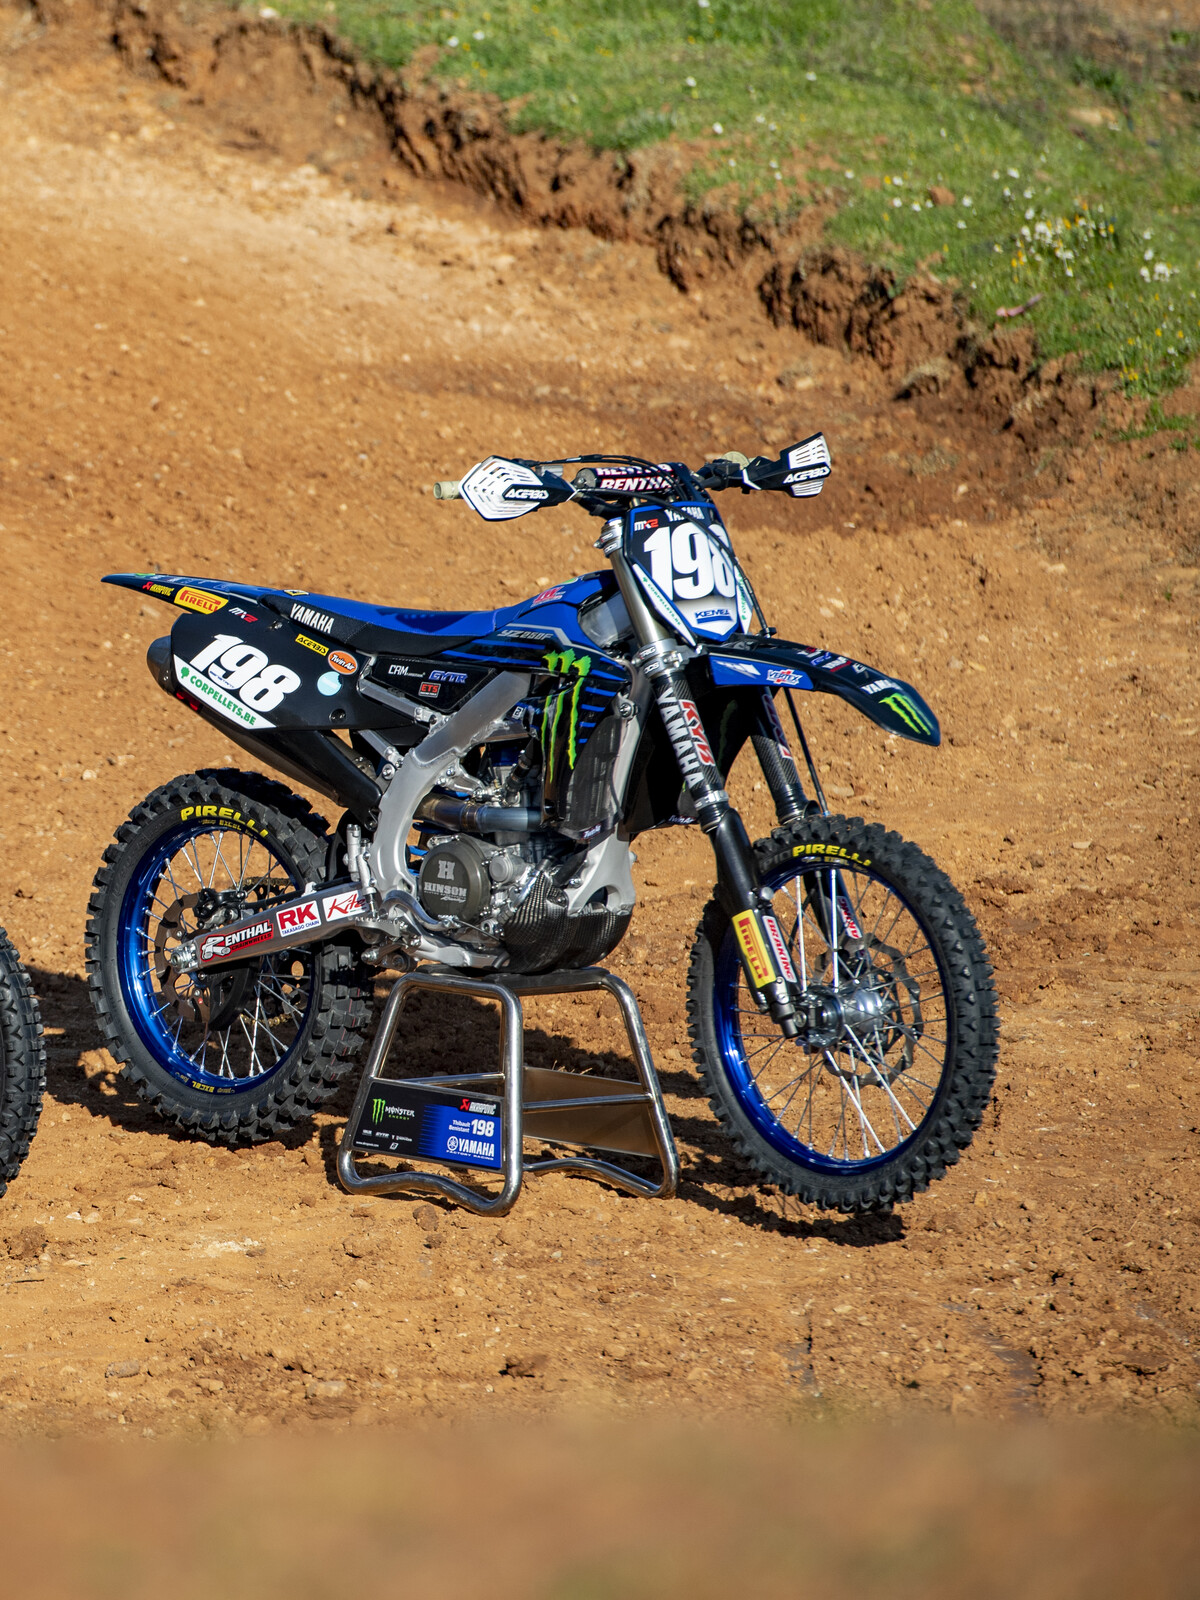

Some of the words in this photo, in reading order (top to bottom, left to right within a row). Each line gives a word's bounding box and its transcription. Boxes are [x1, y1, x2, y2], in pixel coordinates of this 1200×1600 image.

[180, 590, 221, 612] PIRELLI
[290, 603, 334, 634] YAMAHA
[189, 634, 301, 712] 198
[330, 654, 345, 667] Twin
[344, 662, 356, 671] Air
[190, 674, 257, 726] CORPELLETS.BE
[421, 684, 439, 693] ETS
[657, 686, 704, 789] YAMAHA
[679, 700, 716, 767] KYB
[181, 805, 268, 837] PIRELLI
[792, 844, 872, 866] PIRELLI
[424, 881, 467, 897] HINSON
[278, 902, 318, 930] RK
[305, 920, 320, 929] CHAIN
[738, 917, 768, 979] PIRELLI
[768, 919, 794, 979] BRAKING
[385, 1106, 415, 1117] MONSTER
[471, 1118, 495, 1137] 198
[459, 1138, 495, 1157] YAMAHA
